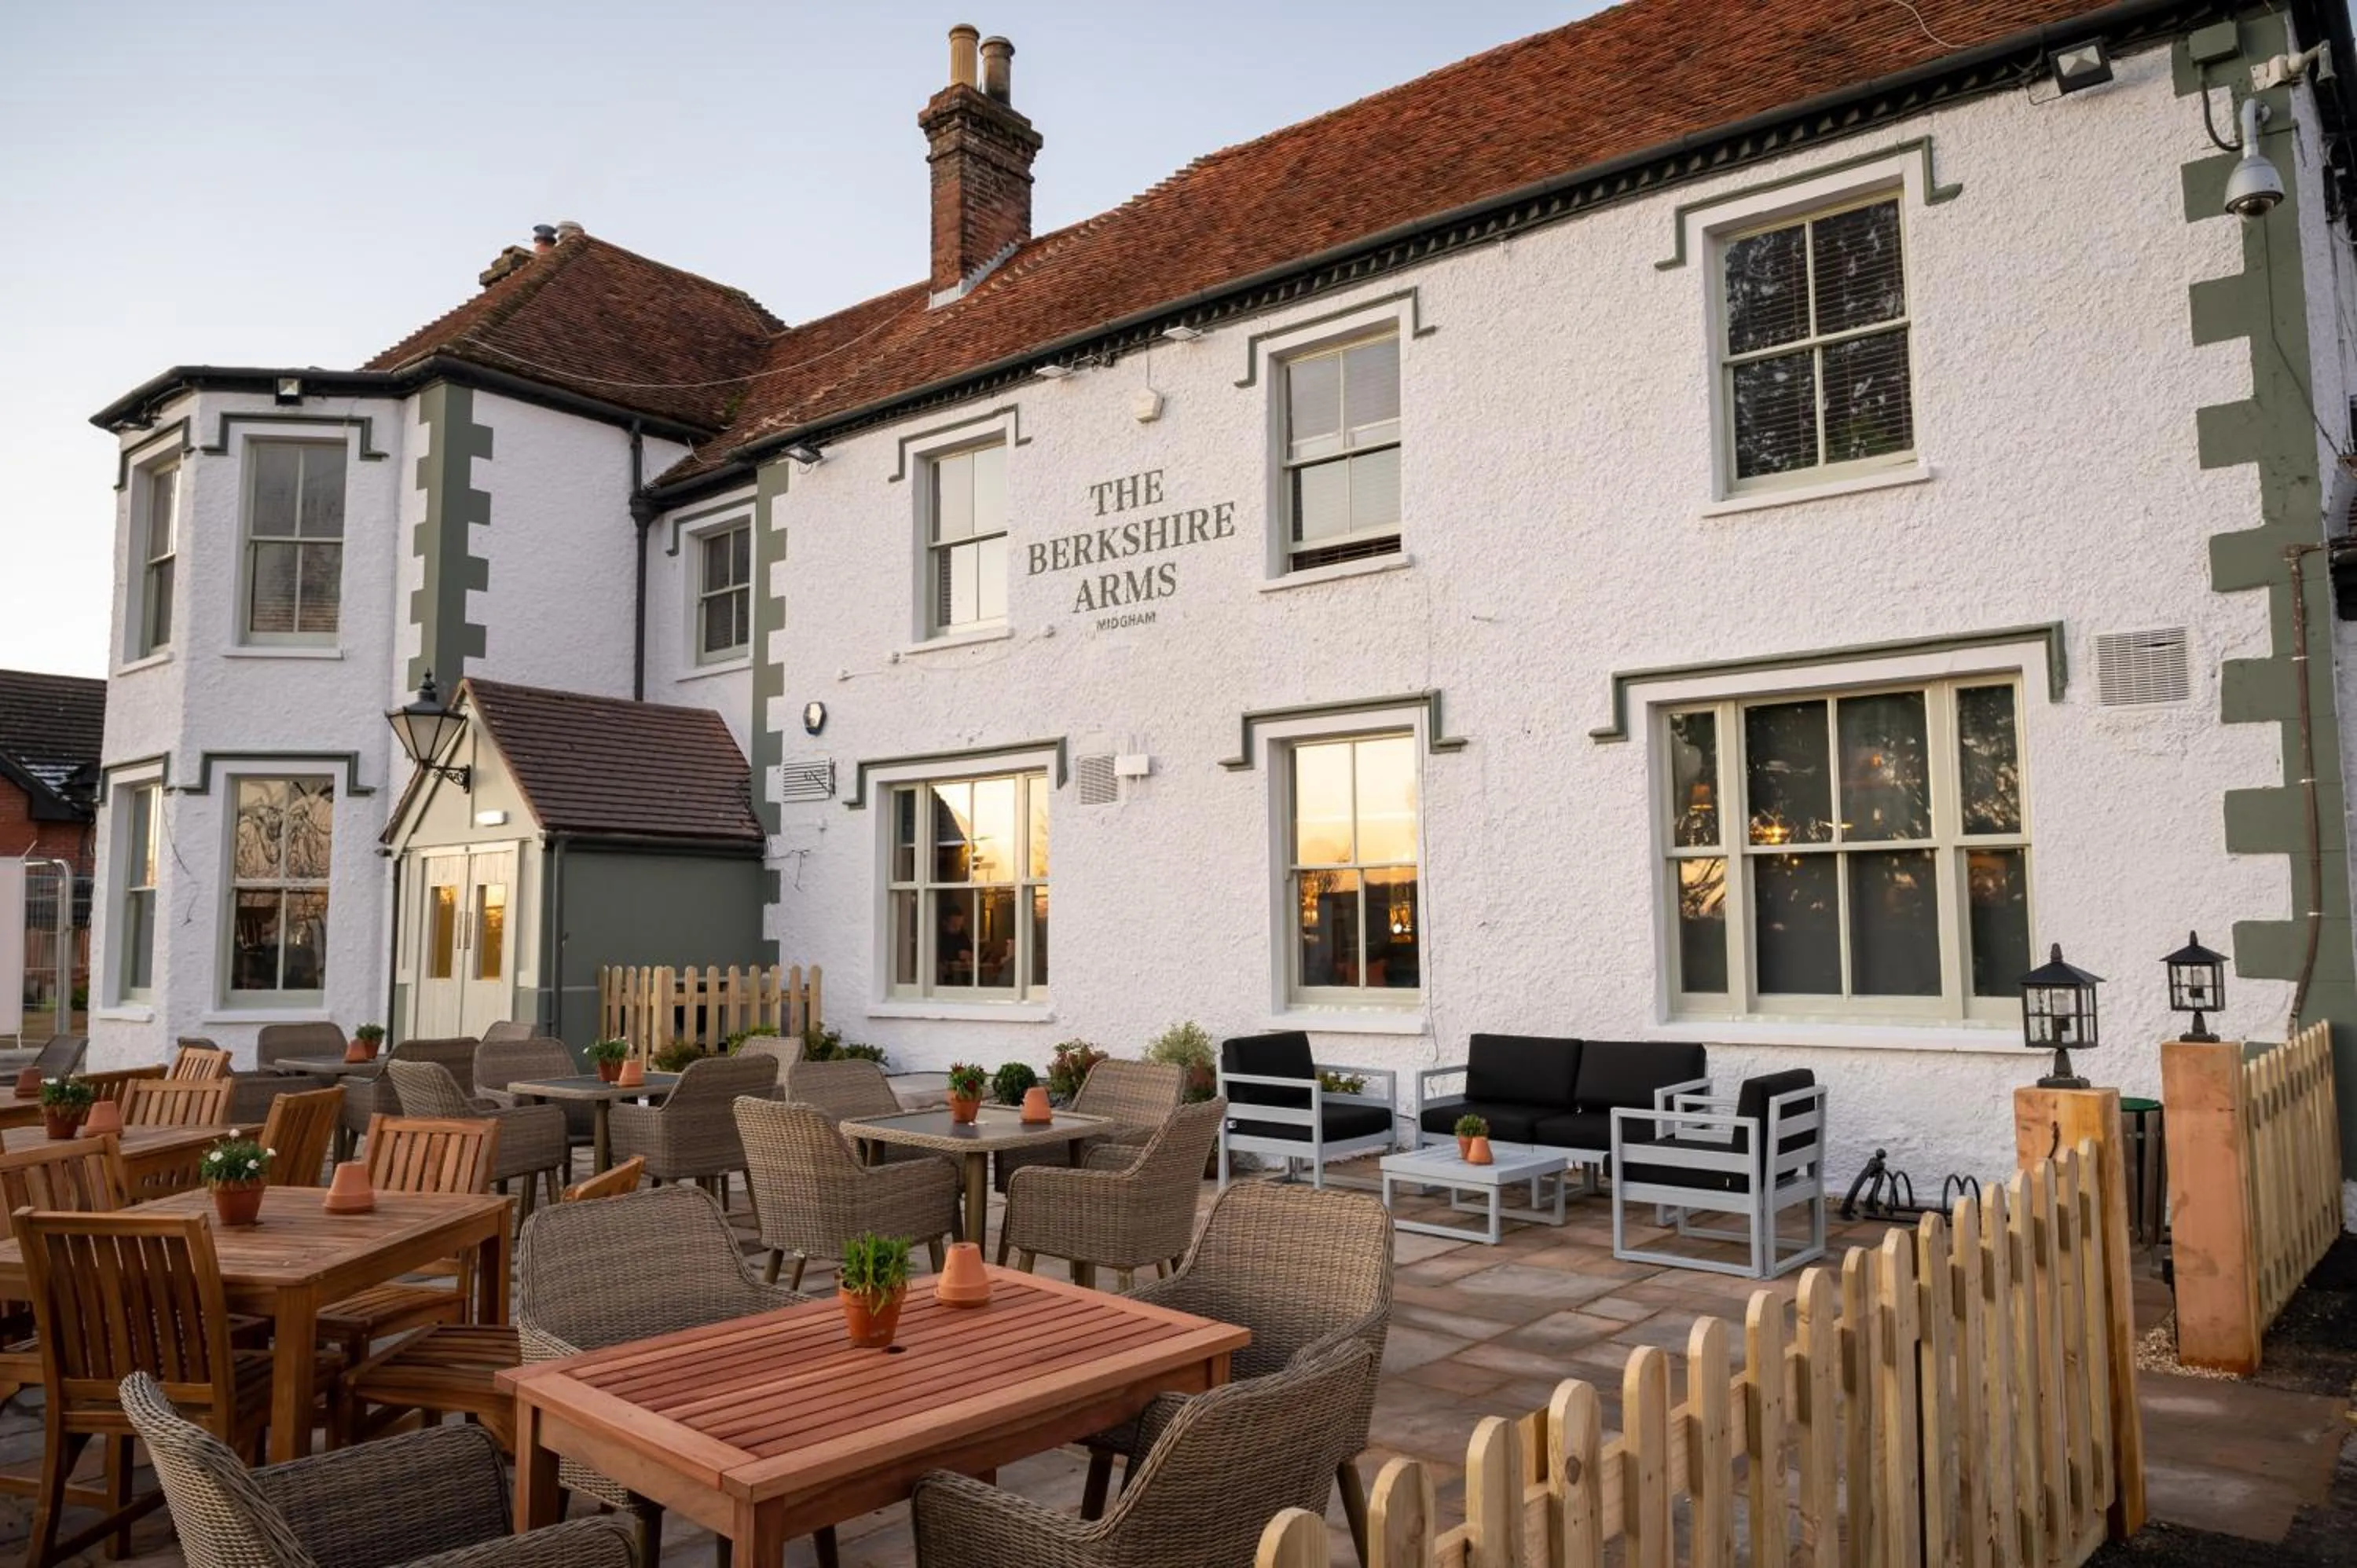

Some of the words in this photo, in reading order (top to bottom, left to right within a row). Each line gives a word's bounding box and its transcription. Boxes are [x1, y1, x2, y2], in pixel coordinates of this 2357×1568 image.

[1090, 469, 1164, 516] THE
[1027, 500, 1235, 576] BERKSHIRE
[1072, 562, 1176, 614] ARMS
[1096, 611, 1156, 631] MIDGHAM
